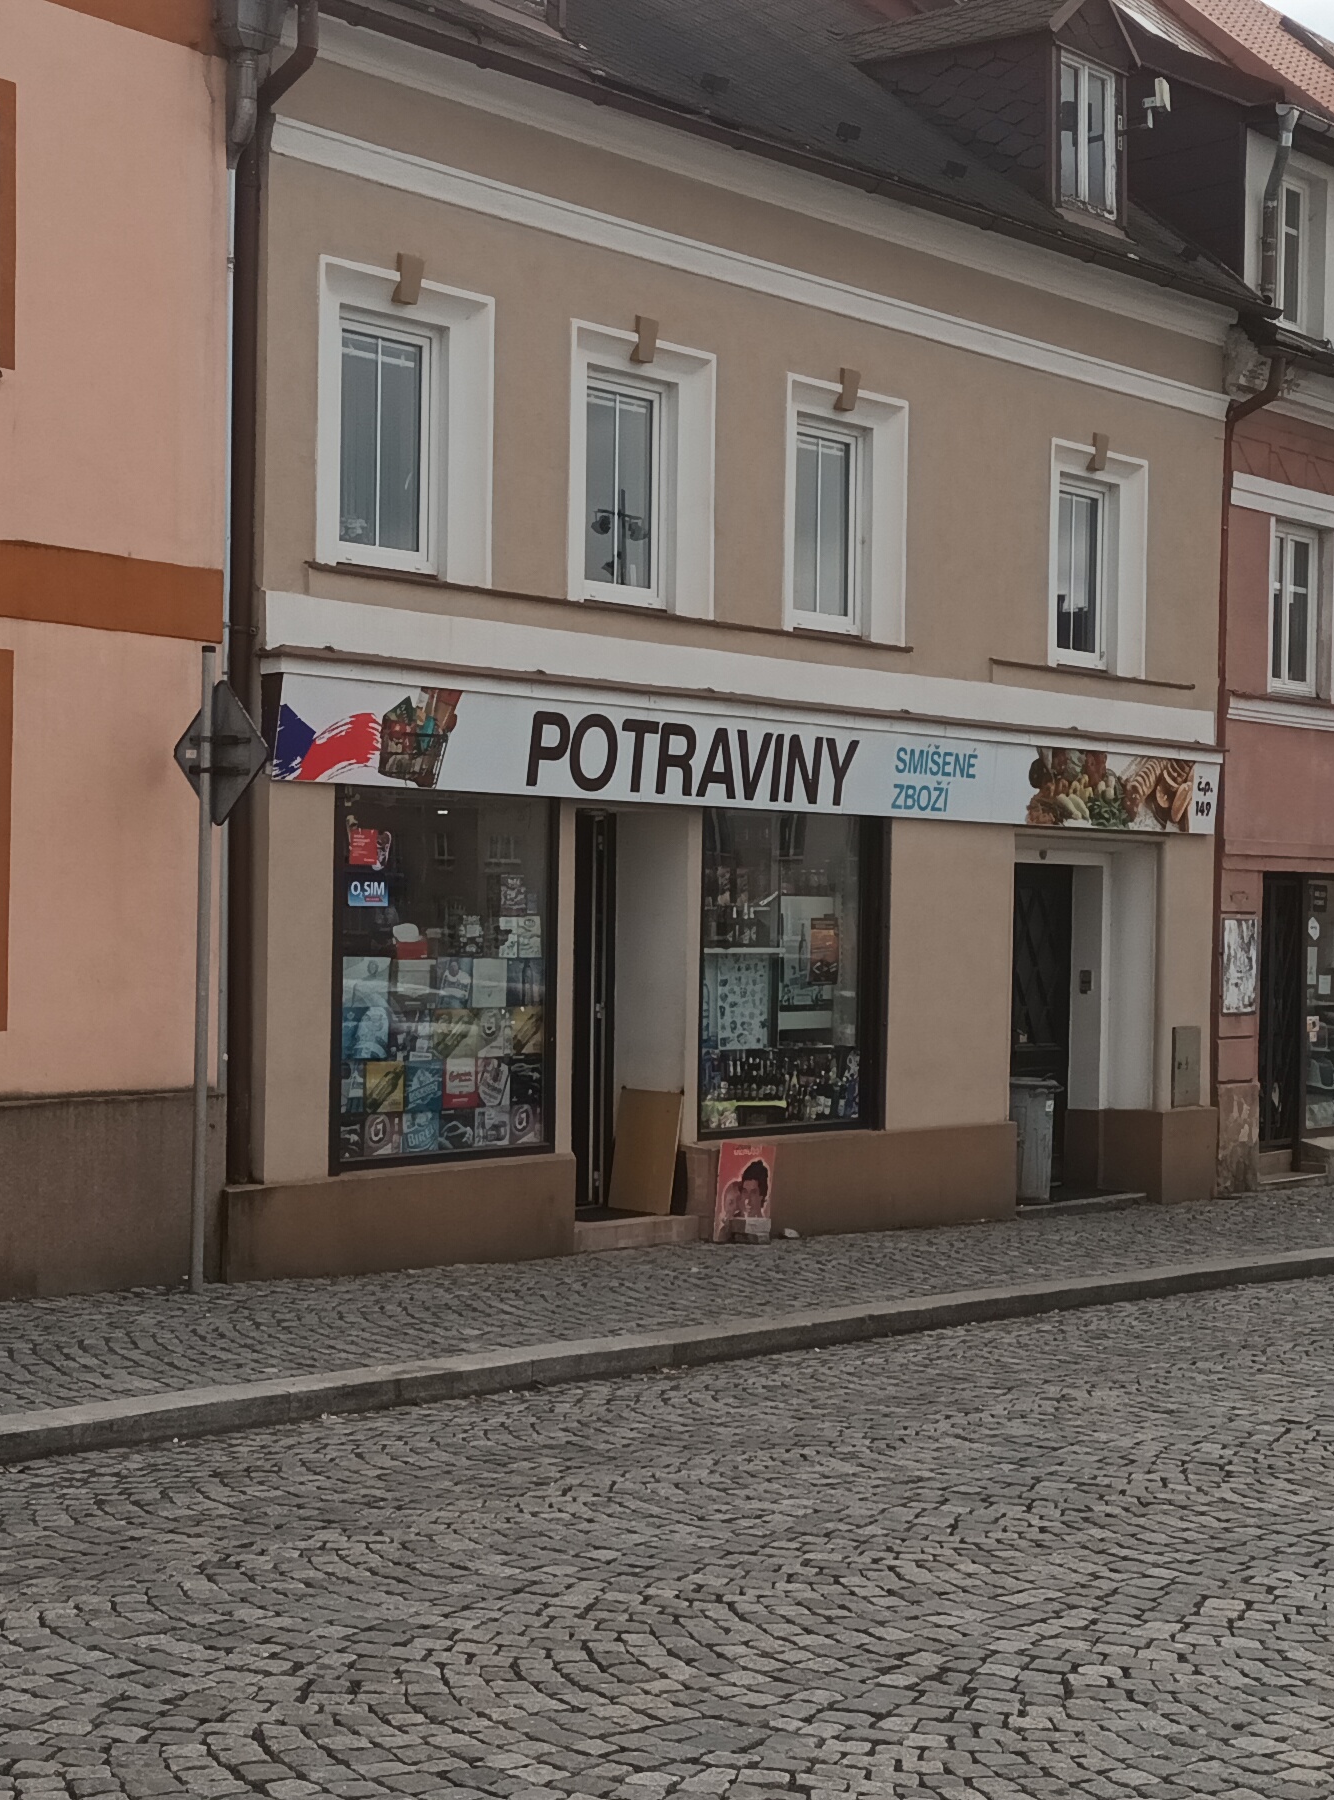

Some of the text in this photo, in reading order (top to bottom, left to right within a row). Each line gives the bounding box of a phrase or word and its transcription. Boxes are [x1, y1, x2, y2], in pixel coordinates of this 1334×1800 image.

[525, 710, 860, 807] POTRAVINY
[894, 743, 977, 779] SMÍŠENÉ
[890, 782, 951, 813] ZBOŽÍ
[1195, 800, 1213, 817] 149
[364, 881, 385, 897] SIM
